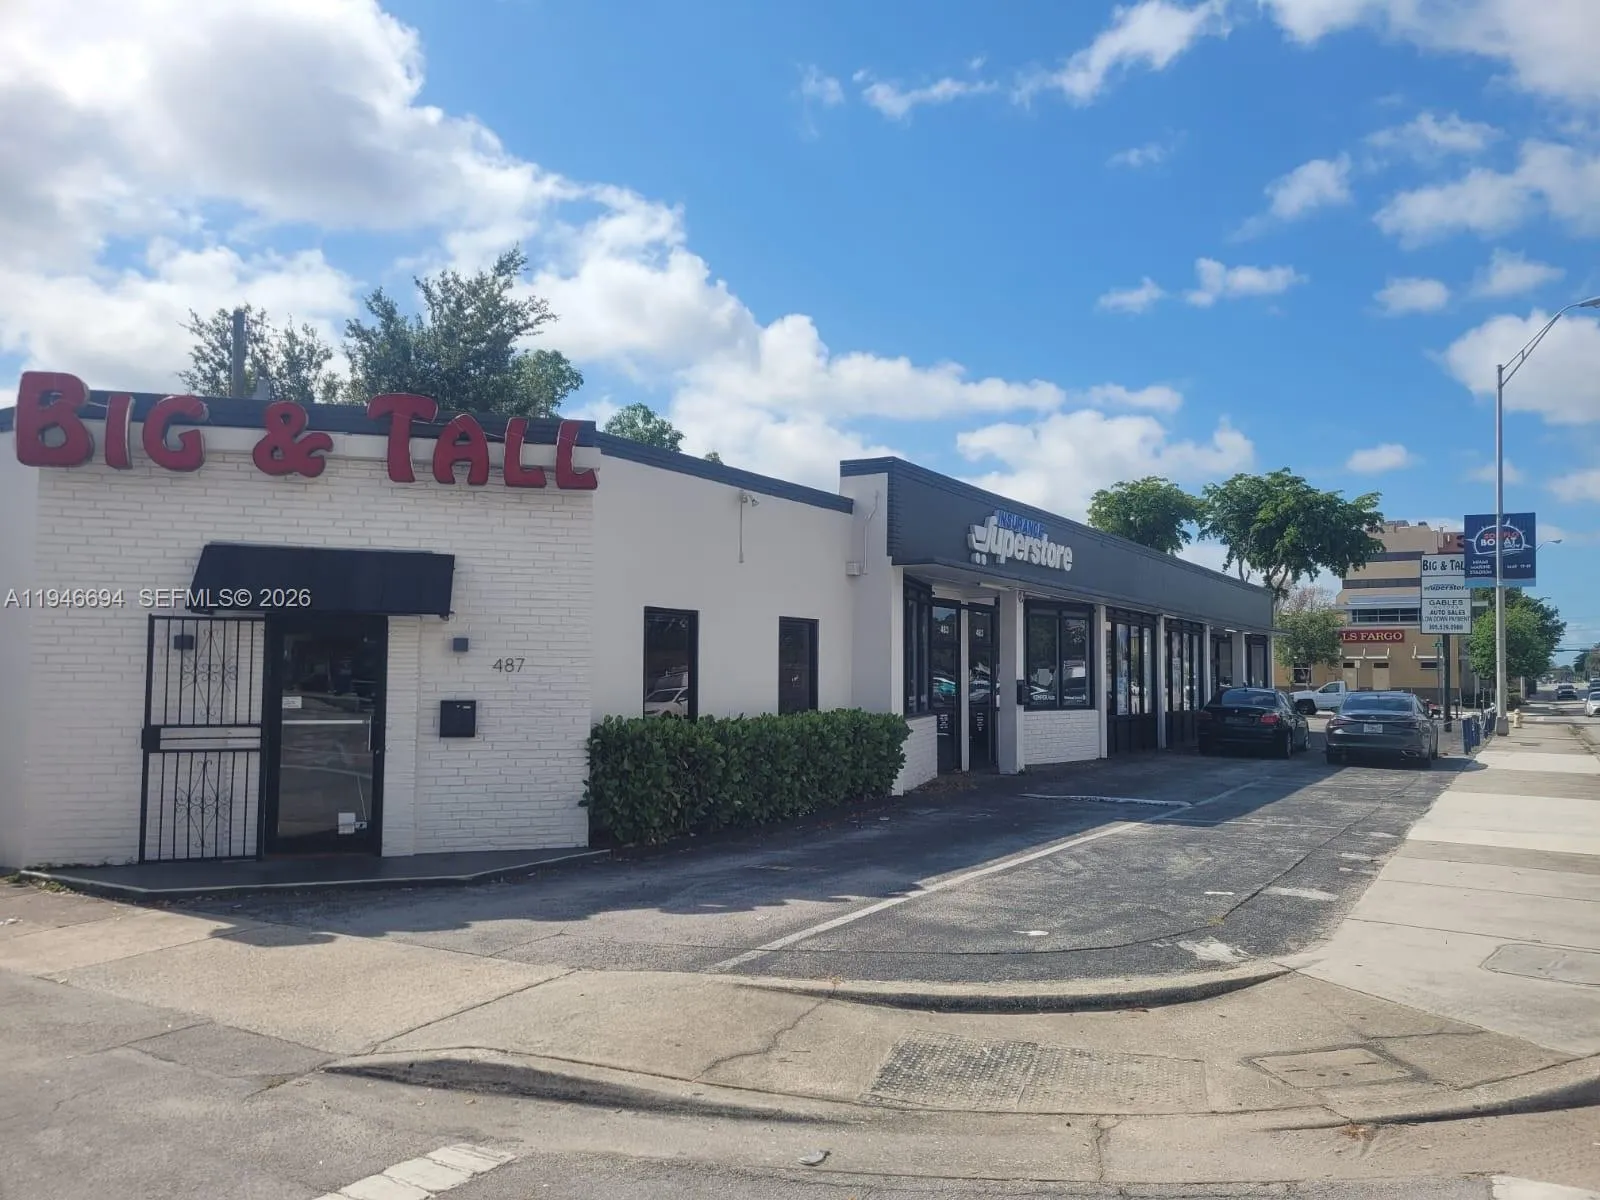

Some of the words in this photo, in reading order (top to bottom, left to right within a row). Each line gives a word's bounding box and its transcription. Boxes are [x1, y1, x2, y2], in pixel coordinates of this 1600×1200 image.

[15, 371, 207, 471] BIG
[252, 401, 333, 478] &
[367, 392, 598, 490] TALL
[1422, 560, 1438, 571] BIG
[1440, 560, 1448, 571] &
[1449, 559, 1465, 571] TAL
[1360, 632, 1402, 641] FARGO
[491, 657, 526, 673] 487
